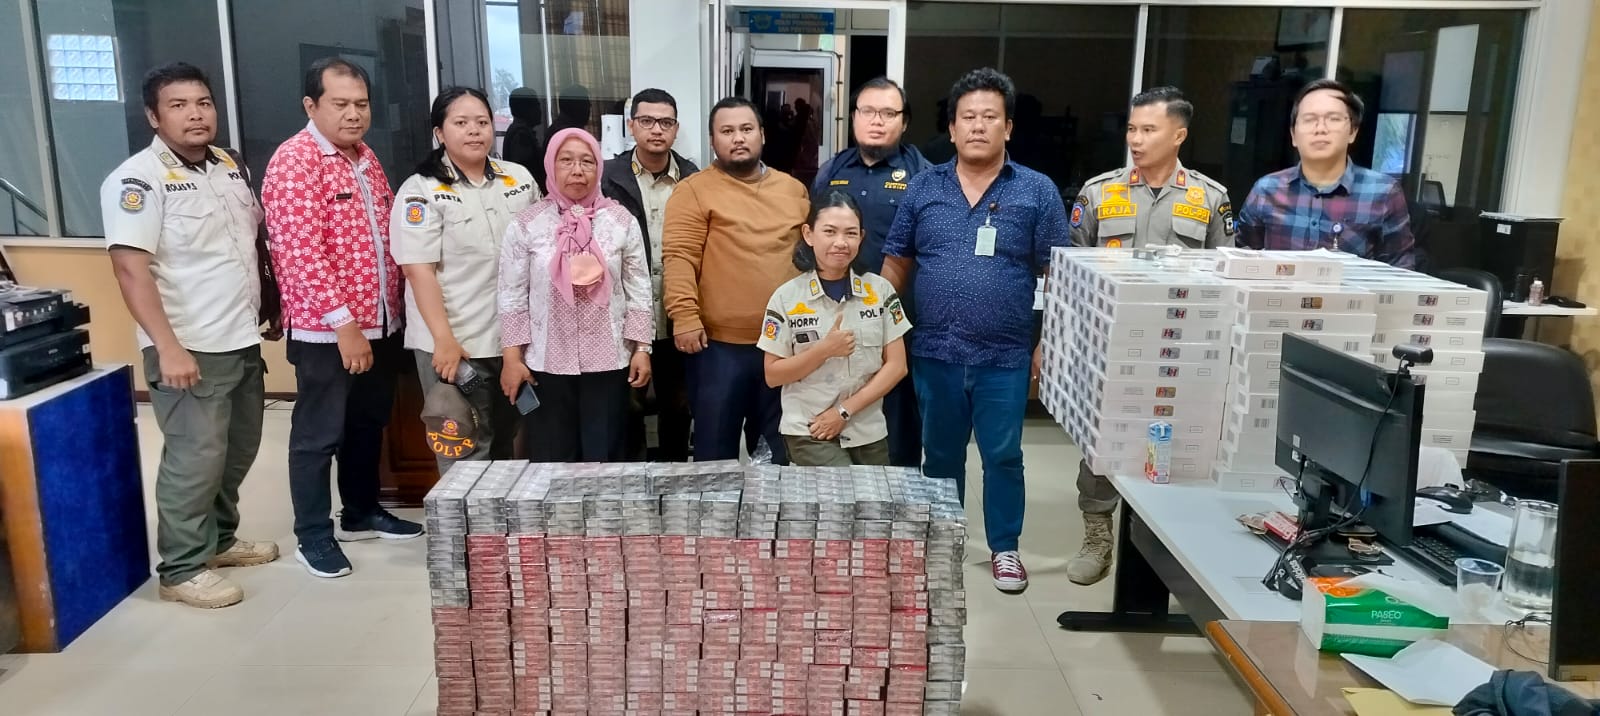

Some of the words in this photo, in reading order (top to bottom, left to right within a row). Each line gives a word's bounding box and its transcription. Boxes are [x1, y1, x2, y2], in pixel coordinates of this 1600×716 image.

[1102, 205, 1131, 215] RAJA
[1175, 204, 1207, 219] POL-PP
[859, 308, 878, 320] POL
[1371, 610, 1402, 621] PASEO
